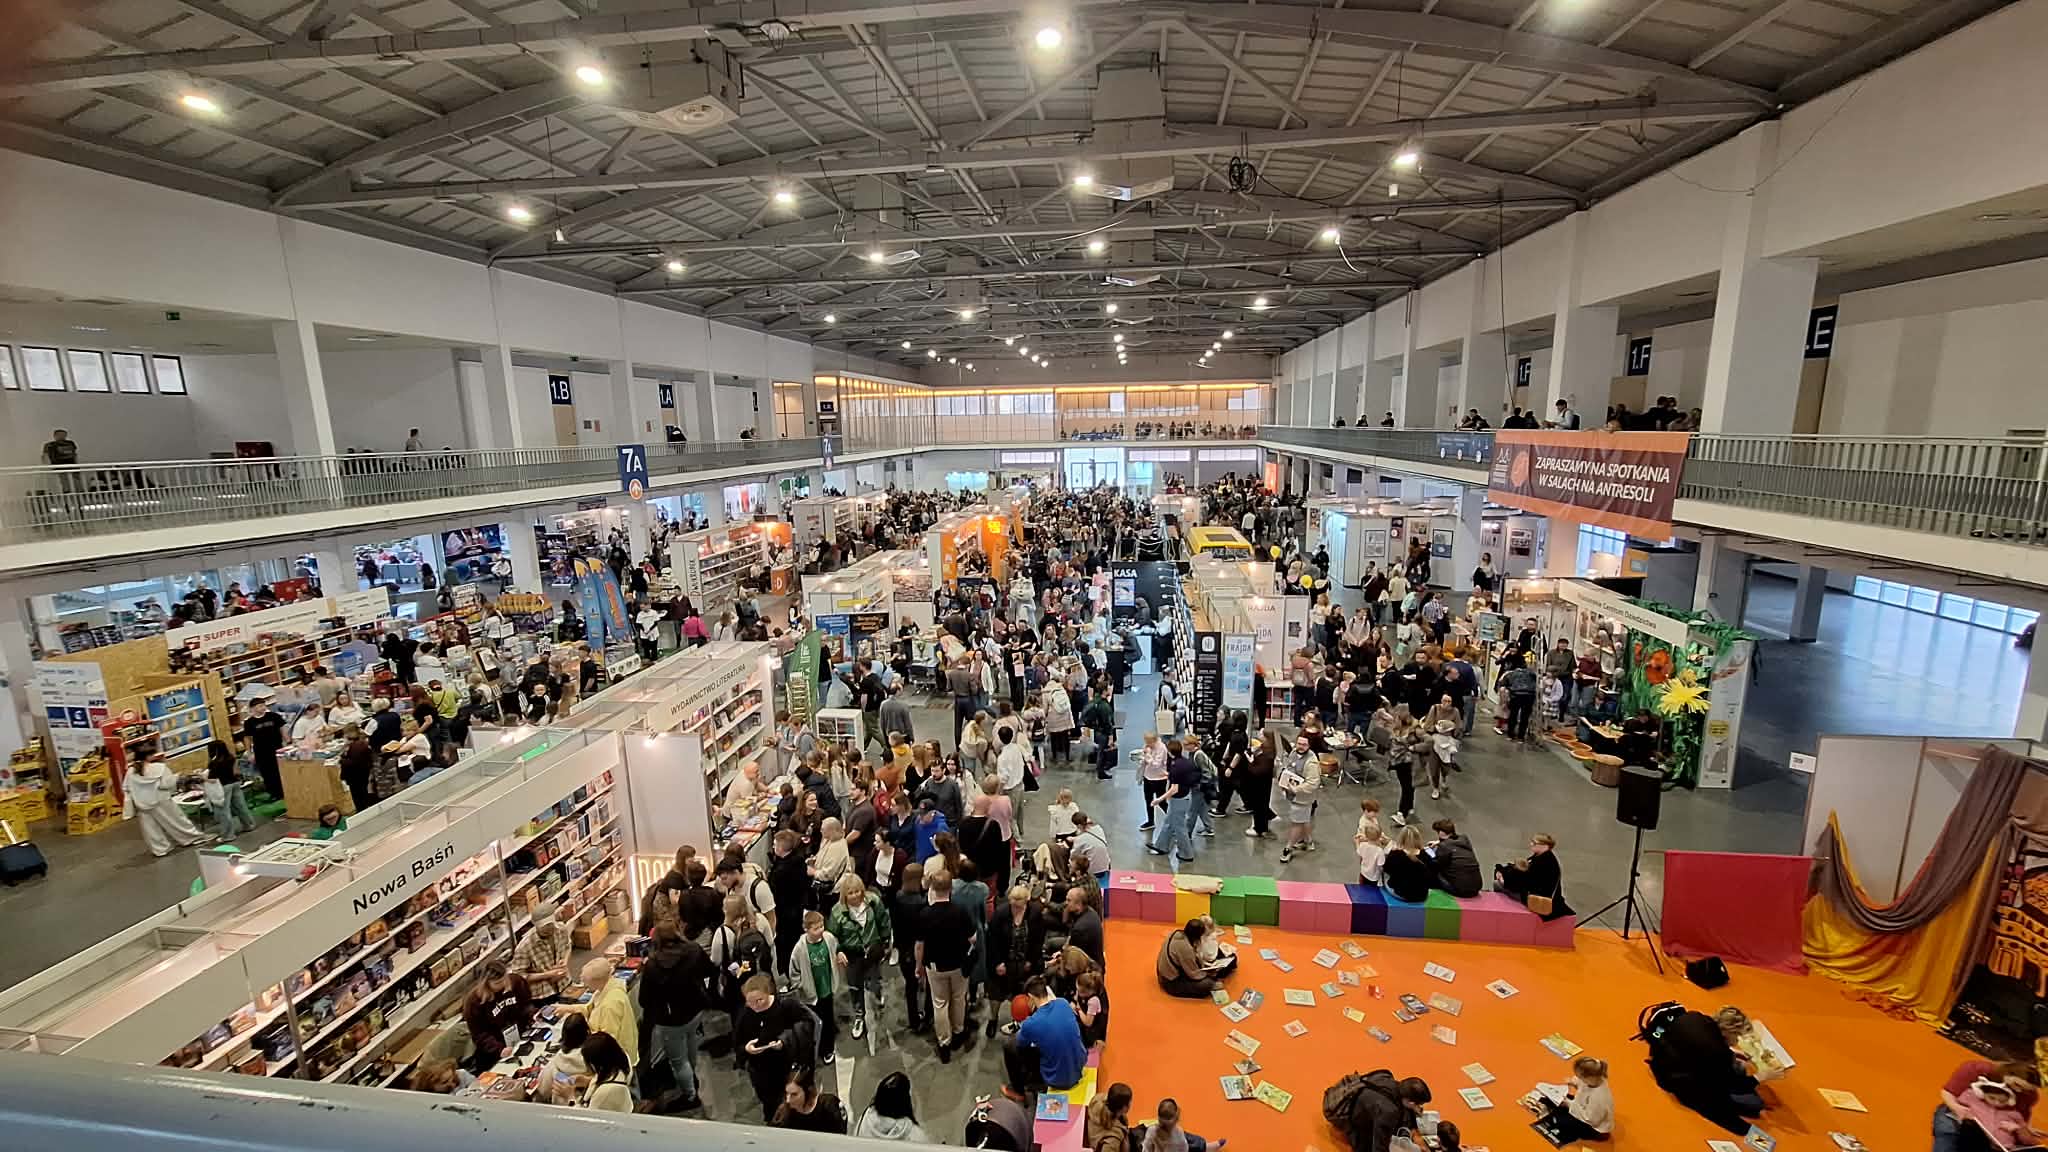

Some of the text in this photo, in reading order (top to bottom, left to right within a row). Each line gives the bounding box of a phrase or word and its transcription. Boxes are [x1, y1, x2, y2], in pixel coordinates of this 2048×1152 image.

[1805, 316, 1833, 350] .E
[1631, 344, 1651, 369] 1.F
[551, 381, 570, 400] 1.B
[660, 389, 673, 405] 1.A
[621, 448, 643, 473] 7A
[1535, 456, 1670, 483] ZAPRASZAMY NA SPOTKANIA
[1538, 473, 1655, 503] W SALACH NA ANTRESOLI
[1114, 568, 1138, 578] KASA
[203, 627, 241, 641] SUPER
[670, 663, 746, 715] WYDAWNICTWO LITERATURA
[352, 842, 454, 915] Nowa Baśń
